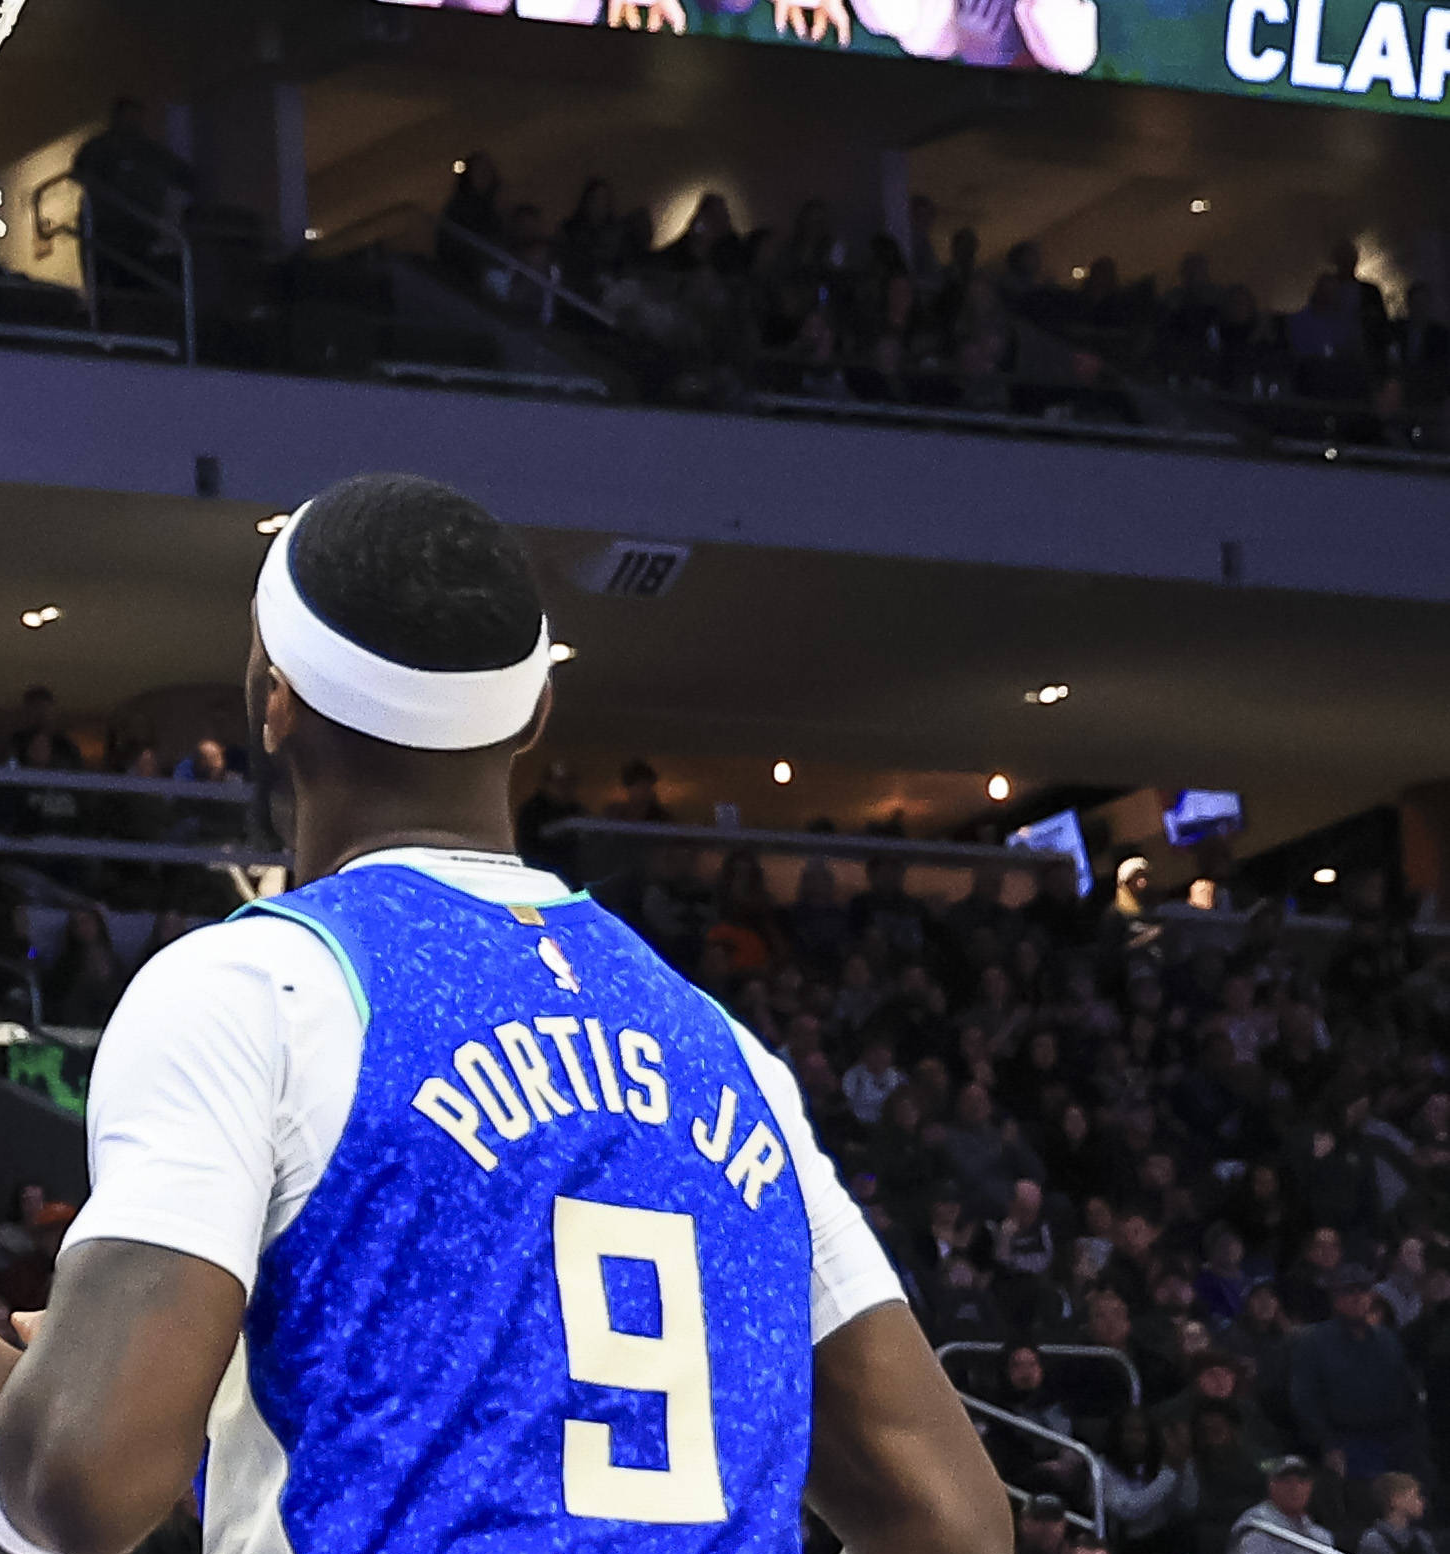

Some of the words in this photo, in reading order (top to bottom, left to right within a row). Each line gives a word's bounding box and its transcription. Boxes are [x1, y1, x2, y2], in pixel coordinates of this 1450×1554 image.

[606, 551, 678, 596] 118
[411, 1015, 670, 1172] PORTIS
[691, 1084, 787, 1210] JR
[553, 1195, 728, 1524] 9
